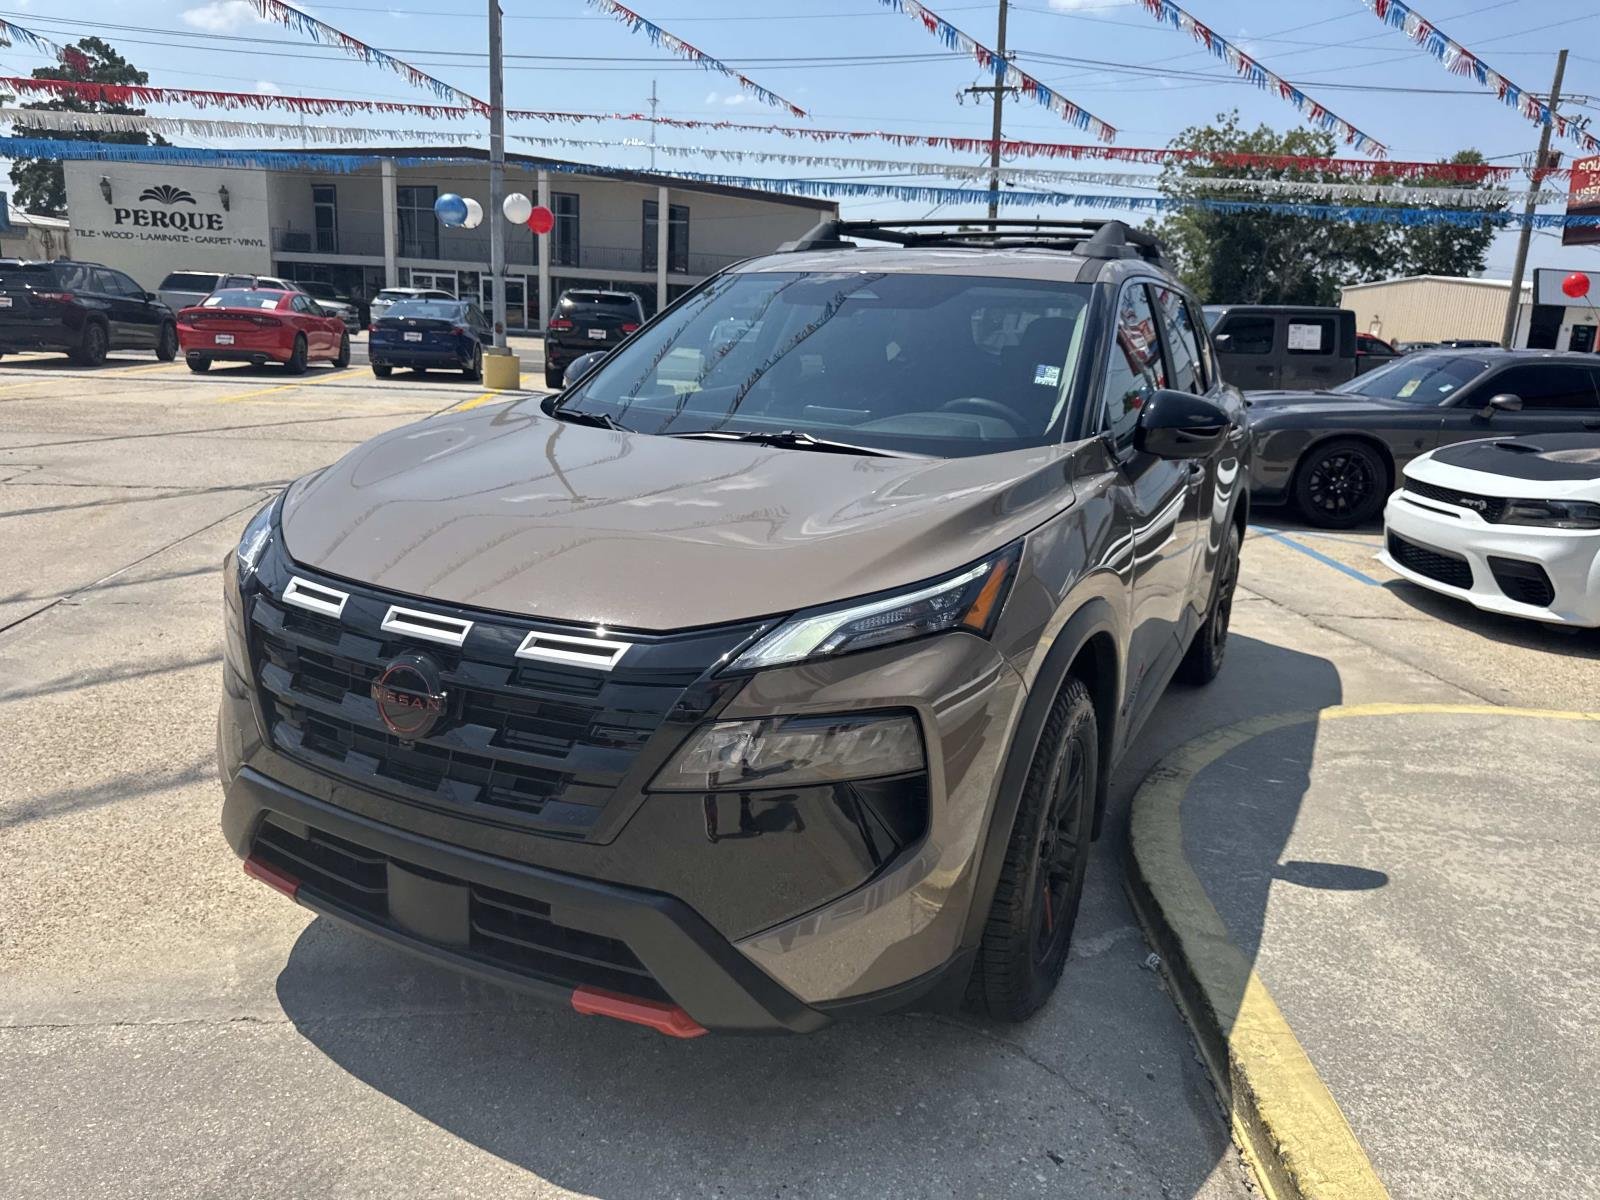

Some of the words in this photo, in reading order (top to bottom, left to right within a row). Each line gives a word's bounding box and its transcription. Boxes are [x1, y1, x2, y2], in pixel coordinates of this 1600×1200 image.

[114, 208, 224, 232] PERQUE
[74, 229, 96, 238] TILE
[102, 230, 134, 240] WOOD
[140, 232, 190, 243] LAMINATE
[195, 235, 232, 245] CARPET
[237, 238, 266, 248] VINYL
[371, 683, 440, 712] NISSAN
